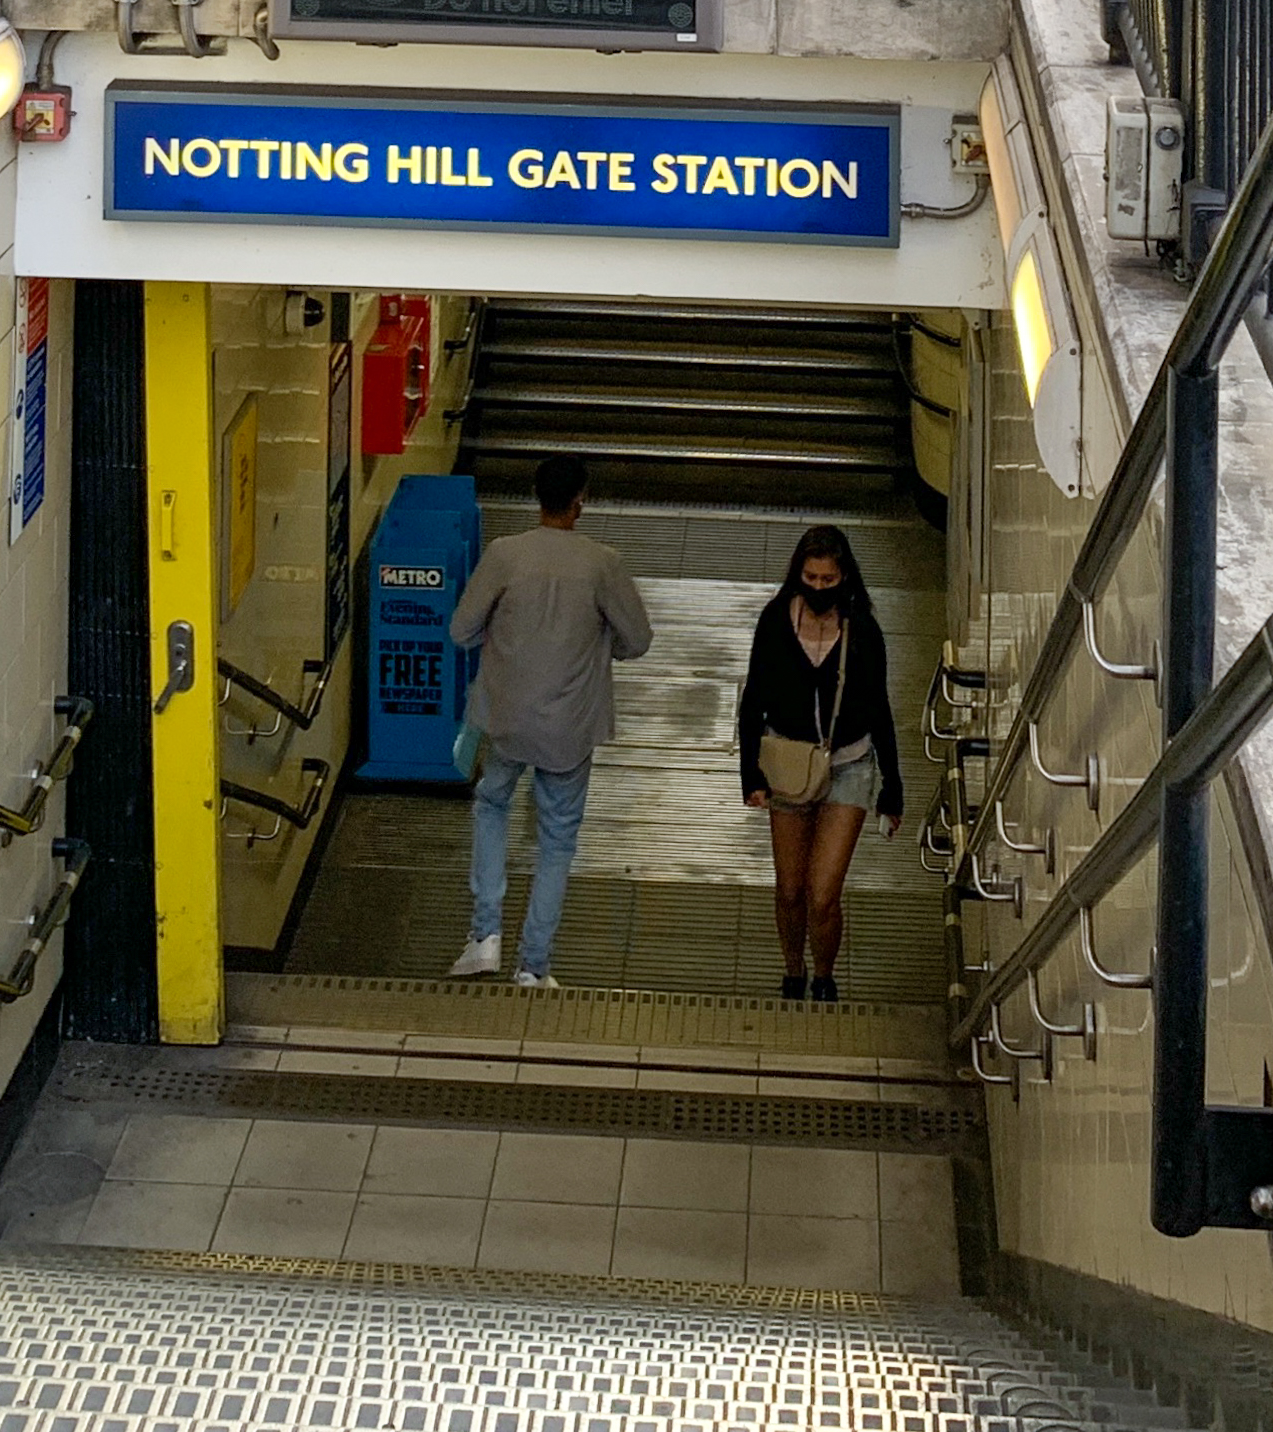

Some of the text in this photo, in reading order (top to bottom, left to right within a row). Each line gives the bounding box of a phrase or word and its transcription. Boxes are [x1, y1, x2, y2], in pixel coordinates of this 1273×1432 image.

[144, 137, 858, 200] NOTTING HILL GATE STATION
[383, 570, 441, 585] METRO
[380, 654, 442, 686] FREE
[379, 687, 442, 700] NEWSPAPER
